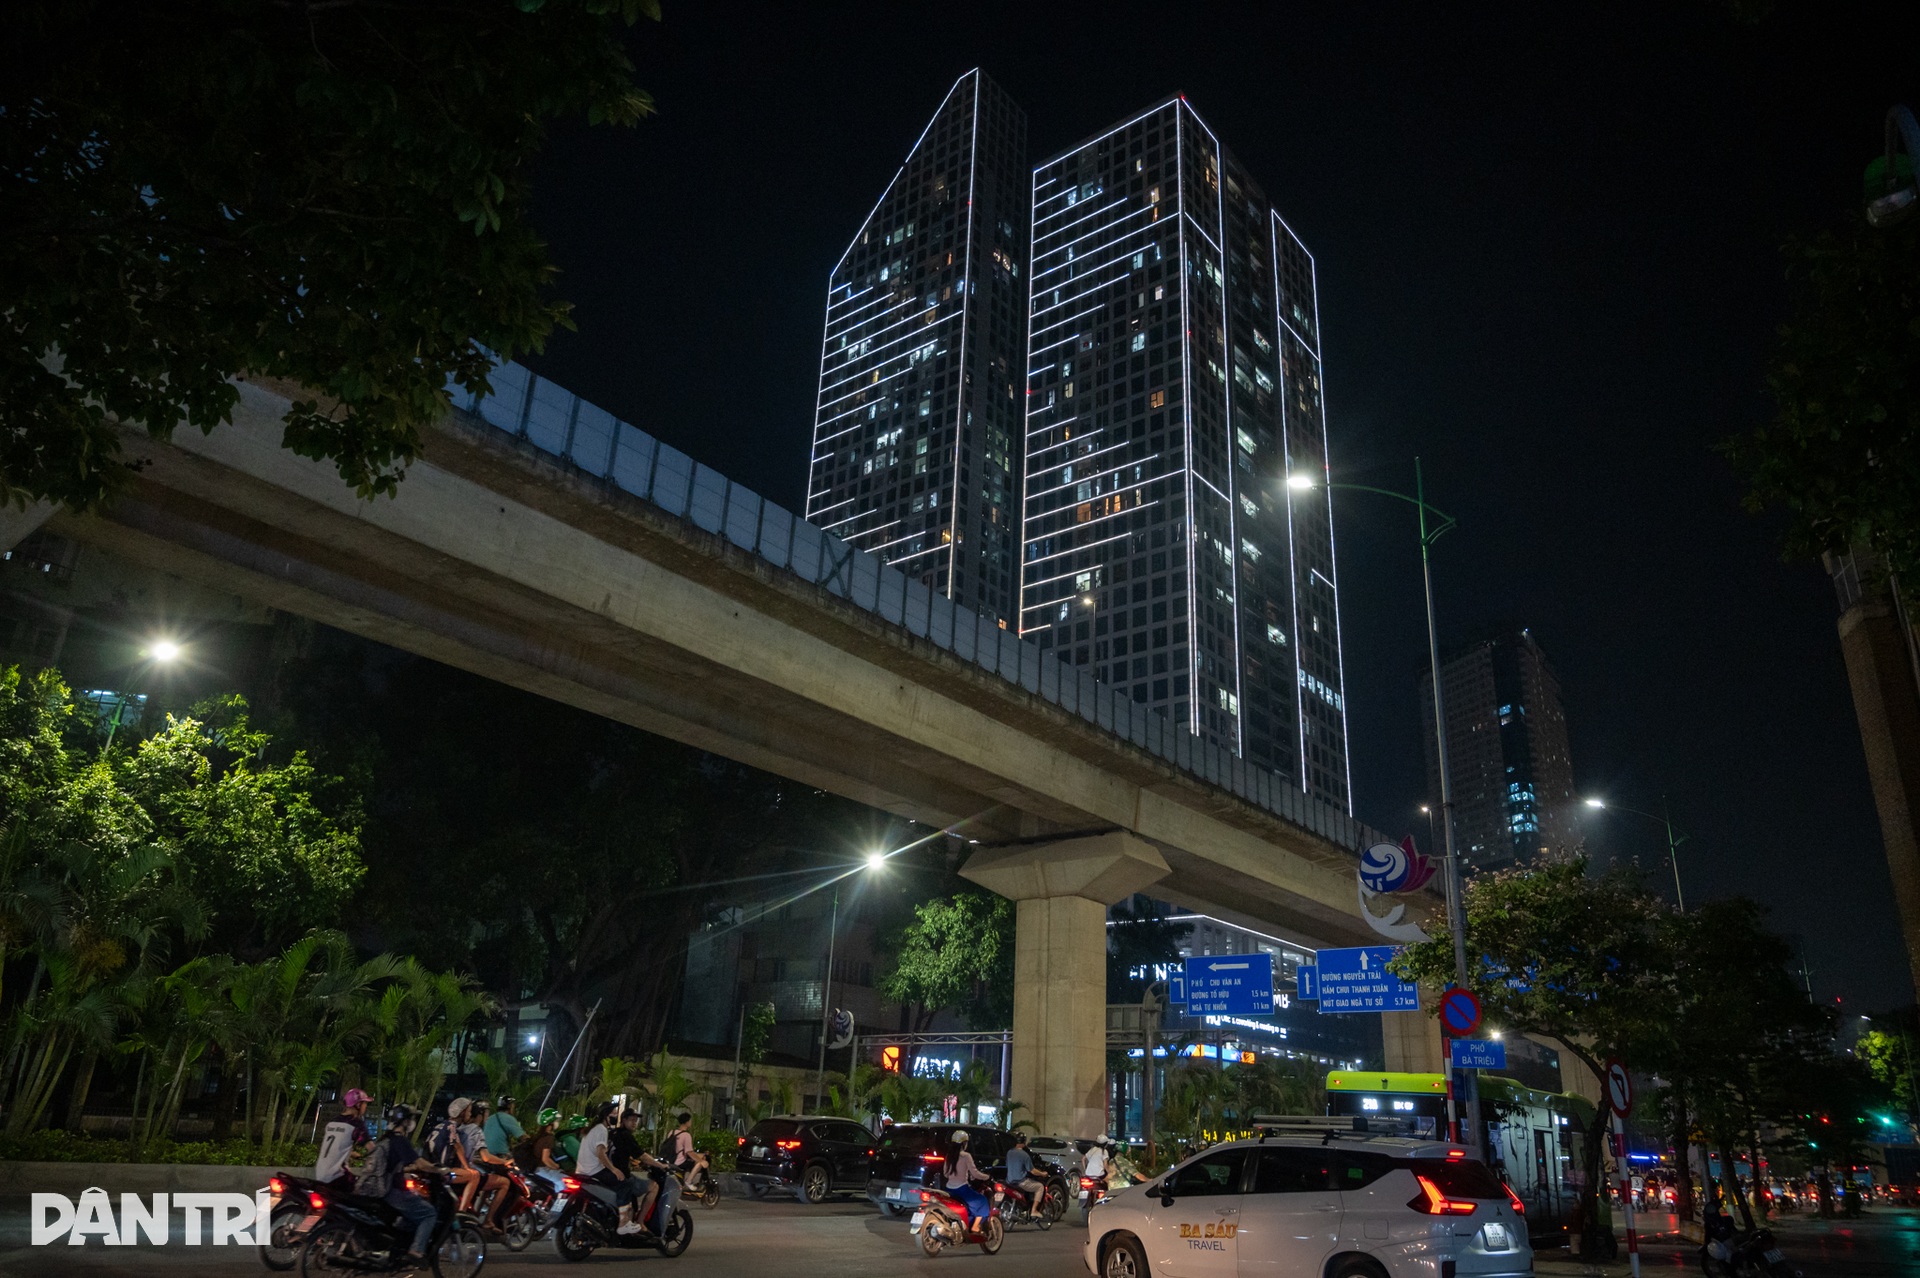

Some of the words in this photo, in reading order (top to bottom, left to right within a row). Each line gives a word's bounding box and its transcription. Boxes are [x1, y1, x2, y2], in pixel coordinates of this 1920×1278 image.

[1321, 971, 1341, 982] ĐƯỜNG
[1343, 970, 1366, 981] NGUYỄN
[1191, 977, 1204, 987] PHỐ
[1210, 979, 1221, 987] CHU
[1234, 978, 1242, 986] AN
[1336, 985, 1350, 994] CHUI
[1351, 985, 1371, 993] THANH
[1372, 983, 1389, 993] XUÂN
[1398, 984, 1402, 992] 3
[1403, 984, 1414, 992] km
[1191, 990, 1209, 999] ĐƯỜNG
[1191, 1002, 1203, 1011] NGÃ
[1253, 1002, 1260, 1010] 11
[1260, 1002, 1270, 1010] km
[1322, 997, 1334, 1007] NÚT
[1335, 998, 1349, 1007] GIAO
[1351, 997, 1363, 1007] NGÃ
[1394, 998, 1404, 1006] 5.7
[1405, 997, 1415, 1005] km
[1470, 1041, 1485, 1053] PHỐ
[1461, 1054, 1473, 1065] BÀ
[1473, 1055, 1496, 1066] TRIỆU
[323, 1134, 336, 1159] 7
[1179, 1223, 1202, 1238] BA
[1204, 1218, 1238, 1239] SÁU
[1187, 1240, 1226, 1251] TRAVEL
